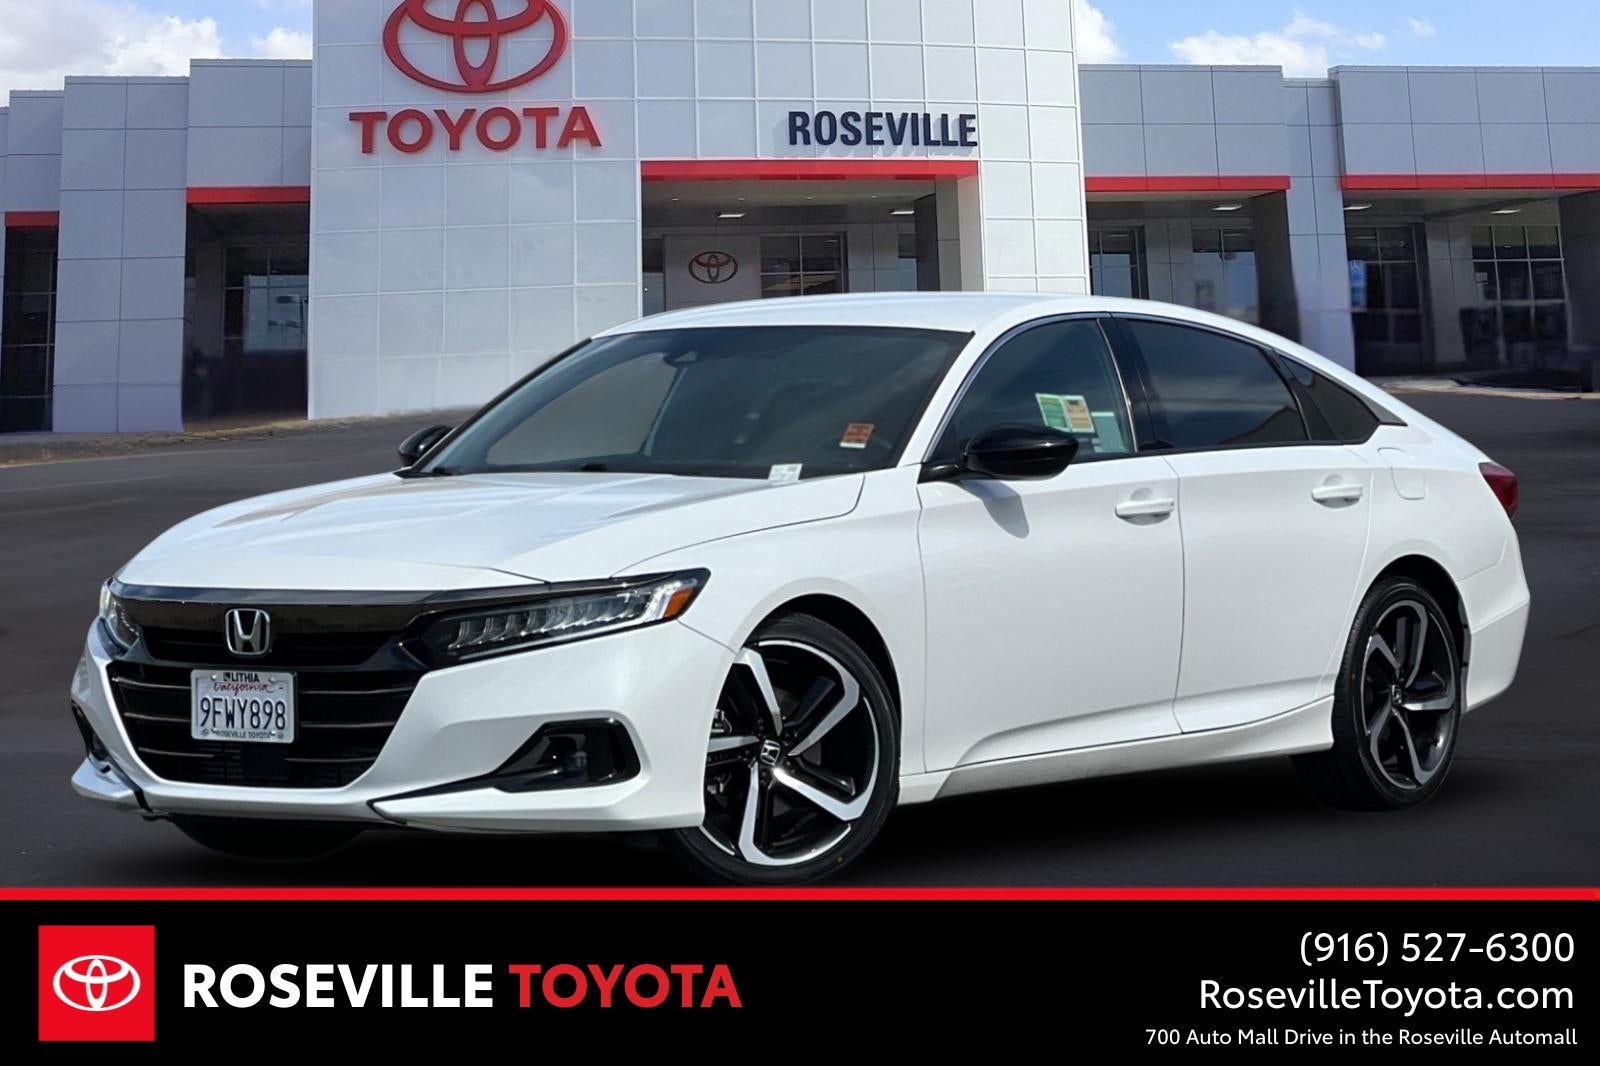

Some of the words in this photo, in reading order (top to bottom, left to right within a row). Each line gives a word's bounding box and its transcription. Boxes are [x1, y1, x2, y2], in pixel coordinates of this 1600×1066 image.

[349, 106, 602, 154] TOYOTA
[788, 110, 978, 148] ROSEVILLE
[213, 682, 273, 696] California
[231, 672, 259, 683] LITHIA
[200, 697, 286, 730] 9FWY898
